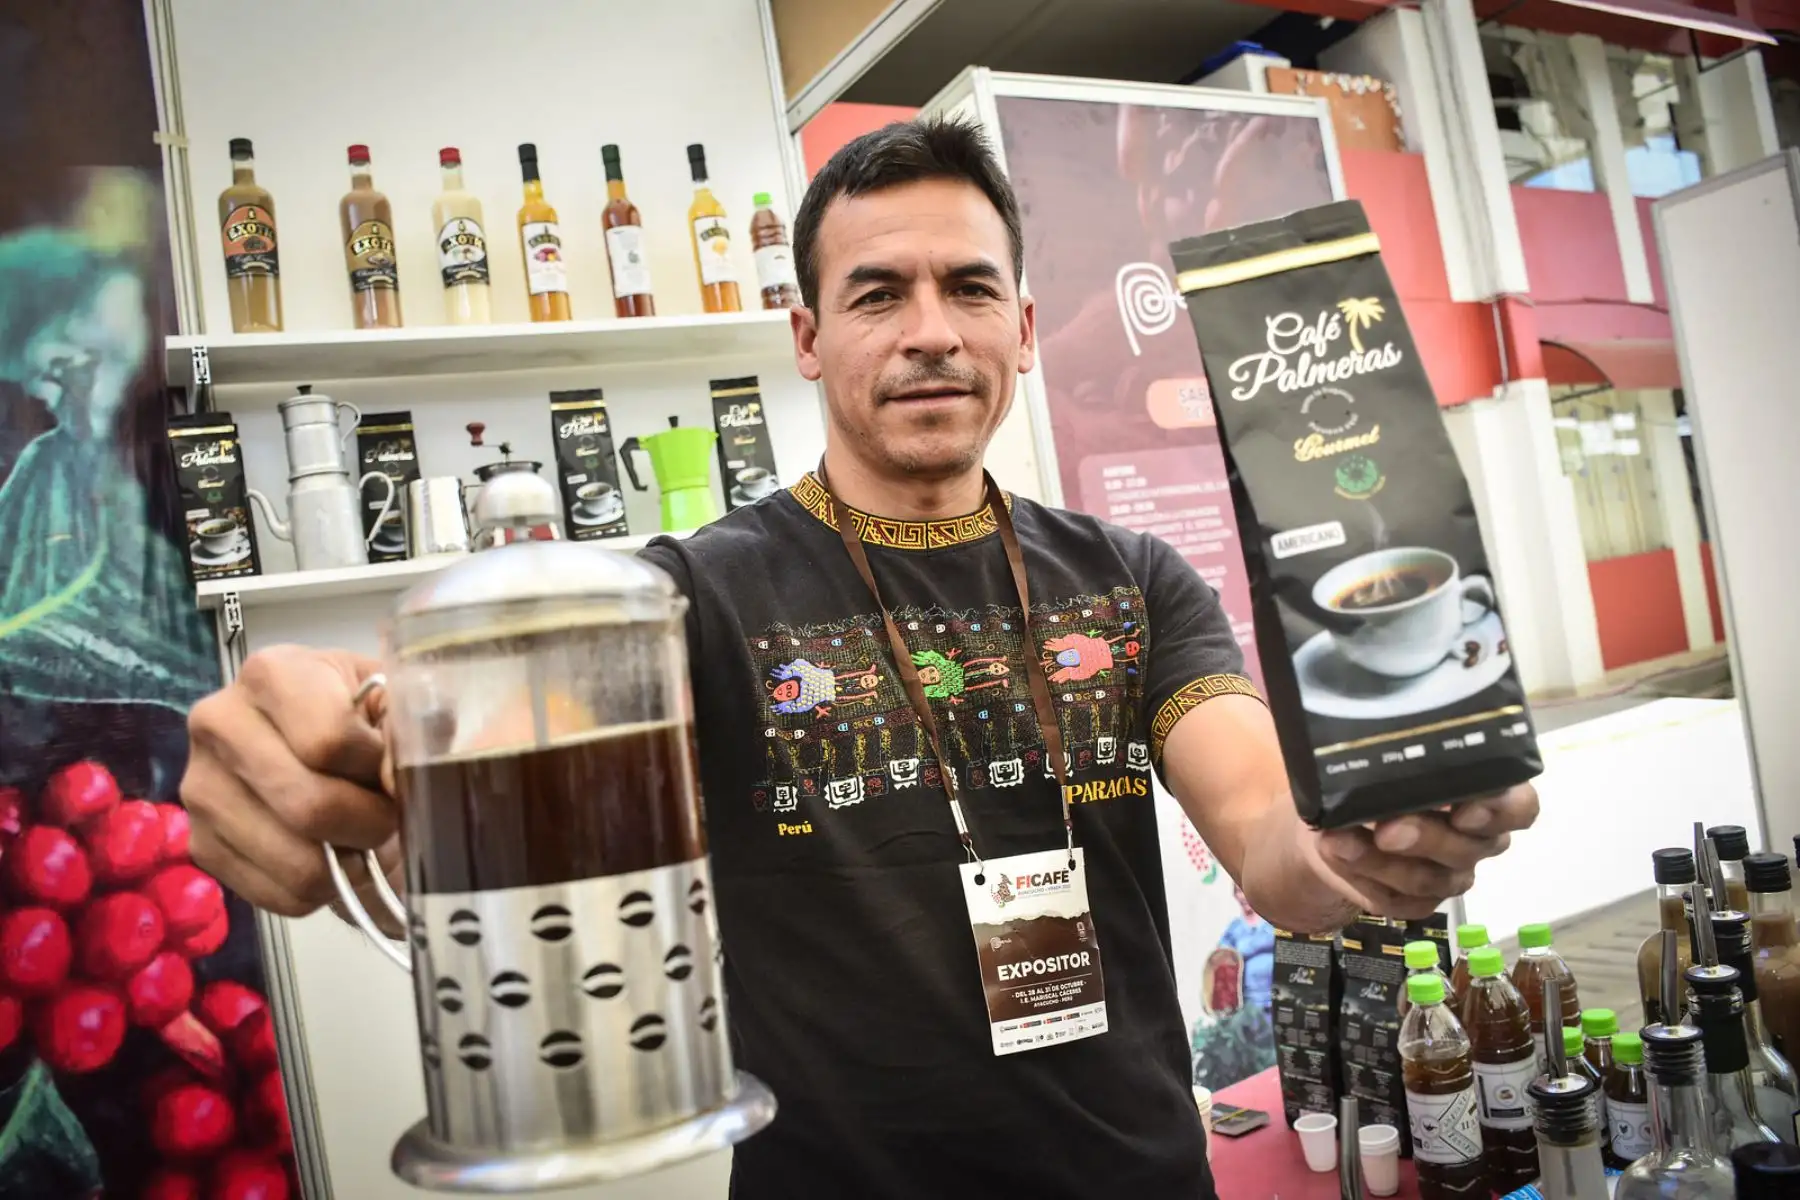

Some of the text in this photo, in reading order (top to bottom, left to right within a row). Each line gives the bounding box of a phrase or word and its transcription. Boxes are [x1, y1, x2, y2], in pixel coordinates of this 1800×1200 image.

[1265, 311, 1341, 357] Café
[1228, 342, 1402, 401] Palmeras
[1278, 526, 1341, 551] AMERICANO
[778, 820, 812, 836] Perú
[1016, 867, 1070, 889] FICAFÉ
[997, 951, 1091, 981] EXPOSITOR
